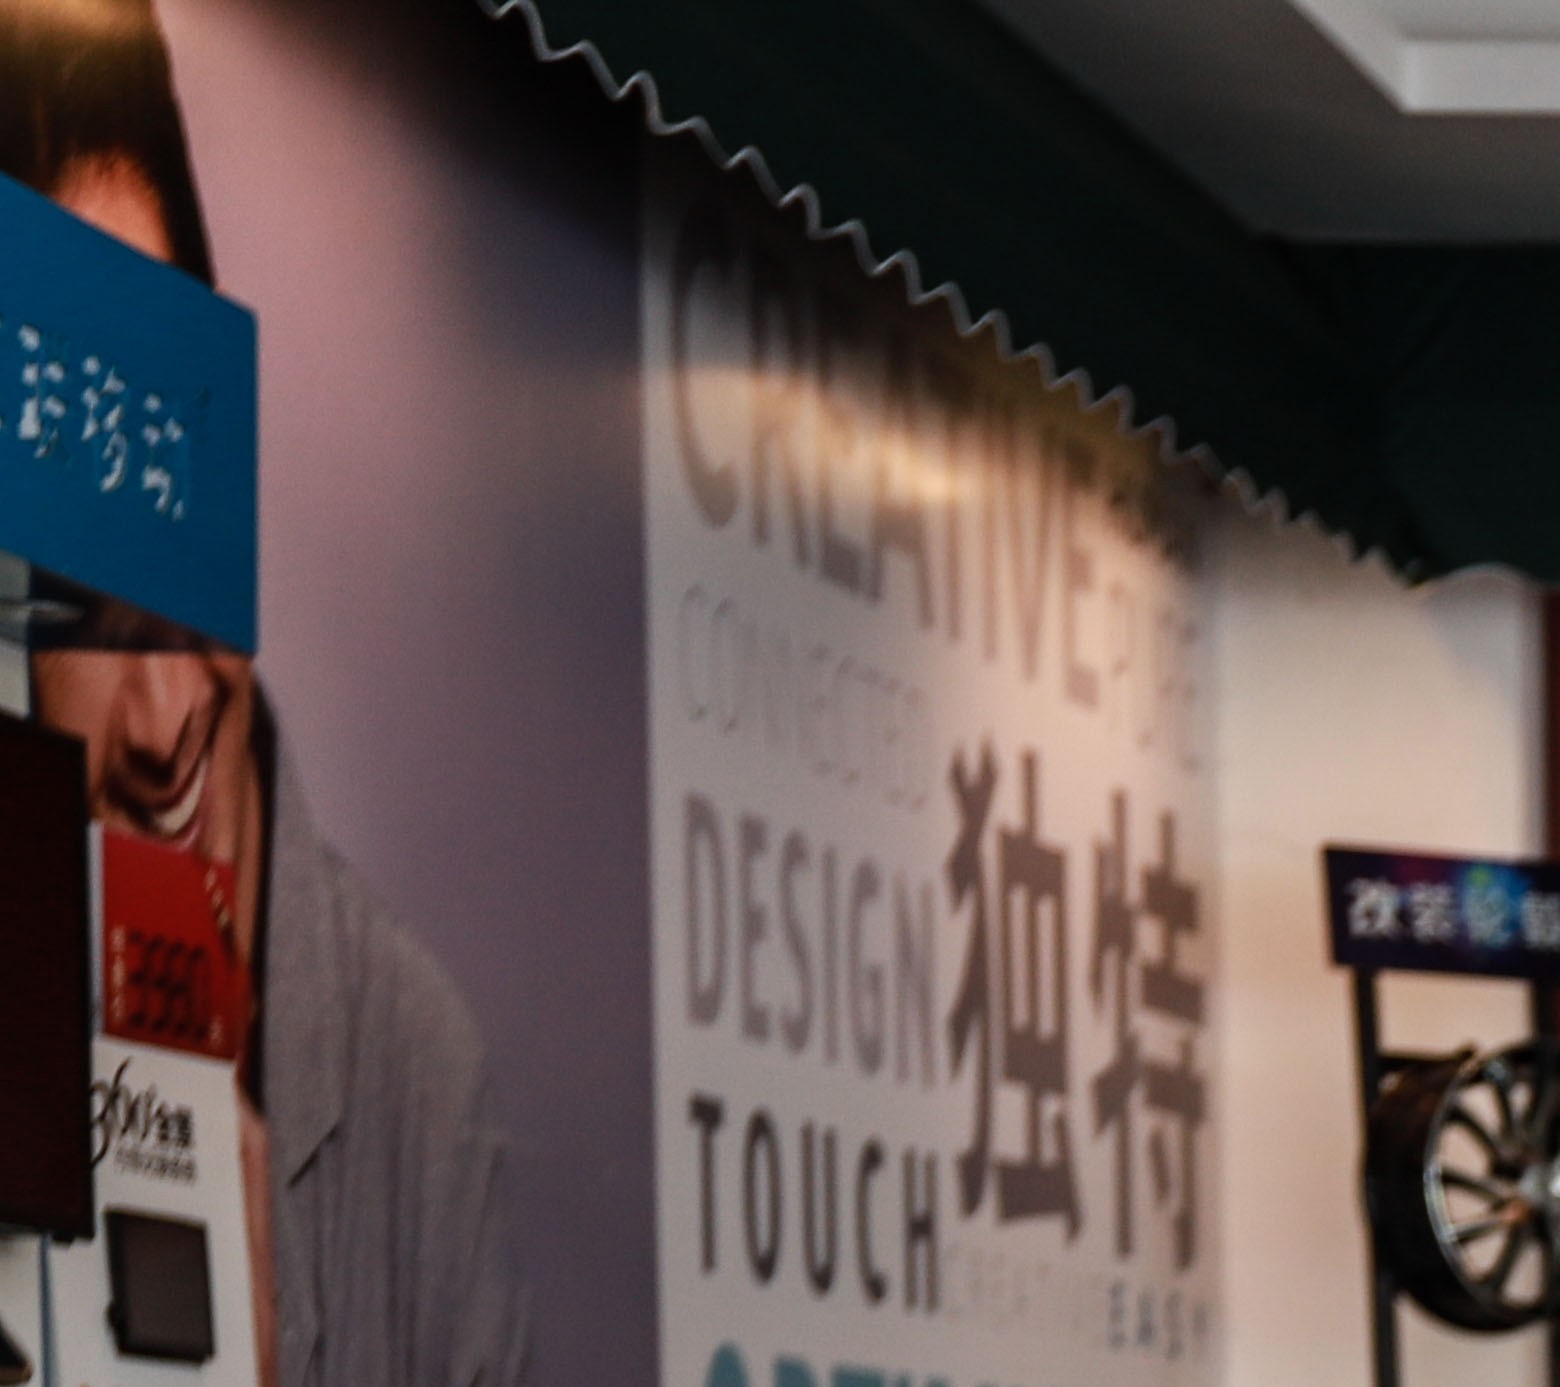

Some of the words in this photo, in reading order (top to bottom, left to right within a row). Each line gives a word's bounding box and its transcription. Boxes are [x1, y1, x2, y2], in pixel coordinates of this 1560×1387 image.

[686, 795, 938, 1092] DESIGN
[945, 730, 1208, 1272] 独特
[687, 1093, 942, 1316] TOUCH
